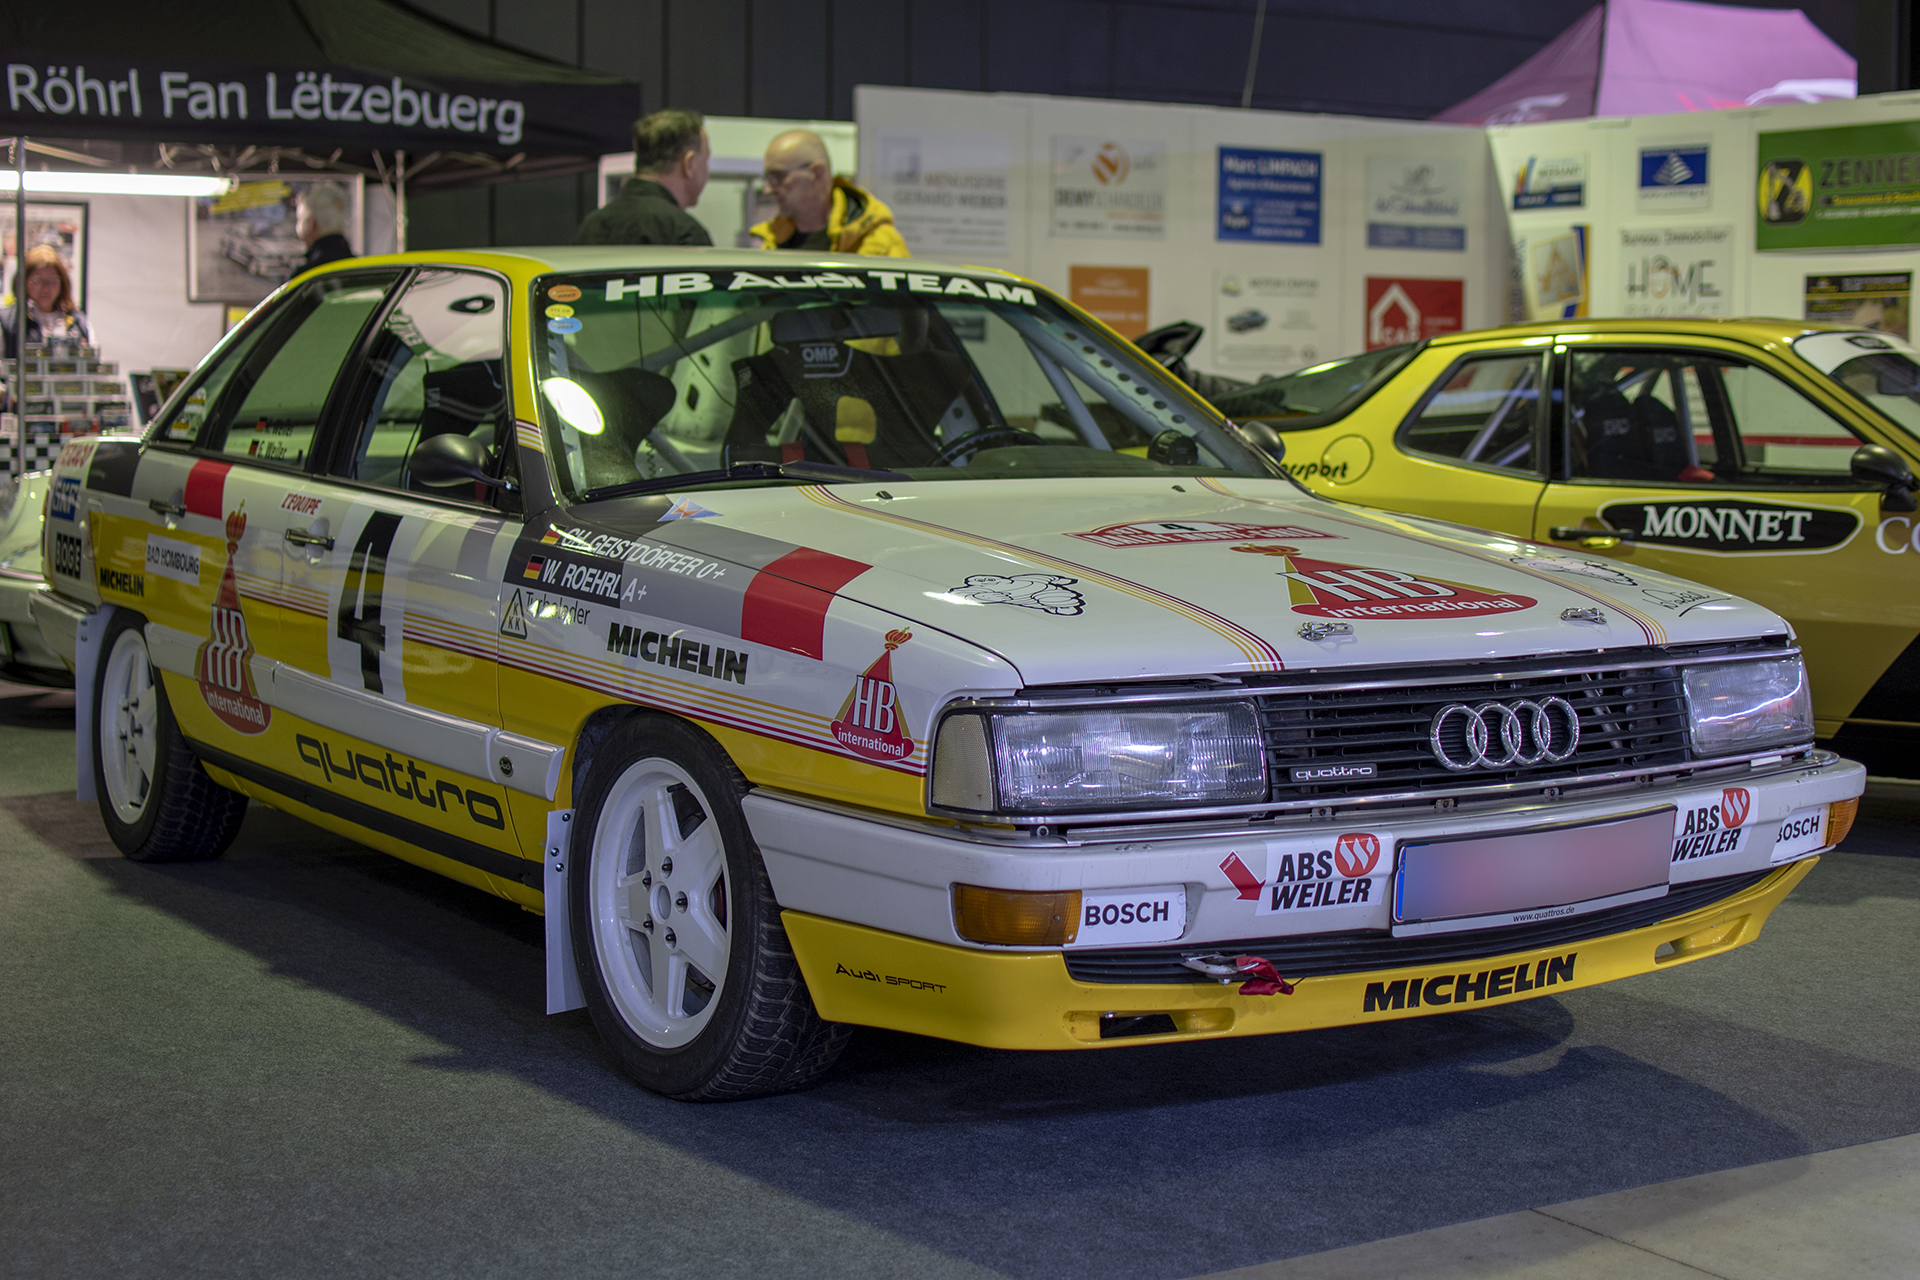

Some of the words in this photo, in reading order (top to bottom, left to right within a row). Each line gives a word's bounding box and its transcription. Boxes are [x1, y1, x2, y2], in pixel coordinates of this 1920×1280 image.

[7, 63, 142, 116] Röhrl
[160, 71, 249, 119] Fan
[265, 70, 525, 144] Lëtzebuerg
[1819, 151, 1920, 189] ZENNE
[605, 271, 714, 301] HB
[728, 271, 866, 290] Audi
[868, 270, 1038, 305] TEAM
[1626, 254, 1722, 304] HOME
[802, 347, 838, 362] OMP
[1641, 505, 1812, 543] MONNET
[1875, 516, 1920, 554] C
[147, 544, 160, 564] BAD
[160, 549, 200, 575] HOMBOURG
[590, 534, 704, 576] GEISTDÖRFER
[100, 567, 145, 598] MICHELIN
[542, 558, 561, 584] W.
[561, 563, 622, 599] ROEHRL
[1275, 569, 1459, 601] HB
[338, 510, 405, 695] 4
[1321, 596, 1525, 618] international
[606, 622, 749, 685] MICHELIN
[205, 684, 266, 727] international
[852, 675, 897, 734] HB
[838, 727, 905, 757] international
[296, 733, 506, 830] quattro
[1295, 766, 1373, 780] quattro
[1681, 805, 1721, 836] ABS
[1671, 827, 1742, 863] WEILER
[1276, 850, 1333, 883] ABS
[1270, 878, 1372, 911] WEILER
[1084, 900, 1169, 926] BOSCH
[1513, 905, 1575, 922] www.quattros.de
[835, 962, 881, 982] Audi
[885, 975, 947, 993] SPORT
[1363, 952, 1578, 1012] MICHELIN
